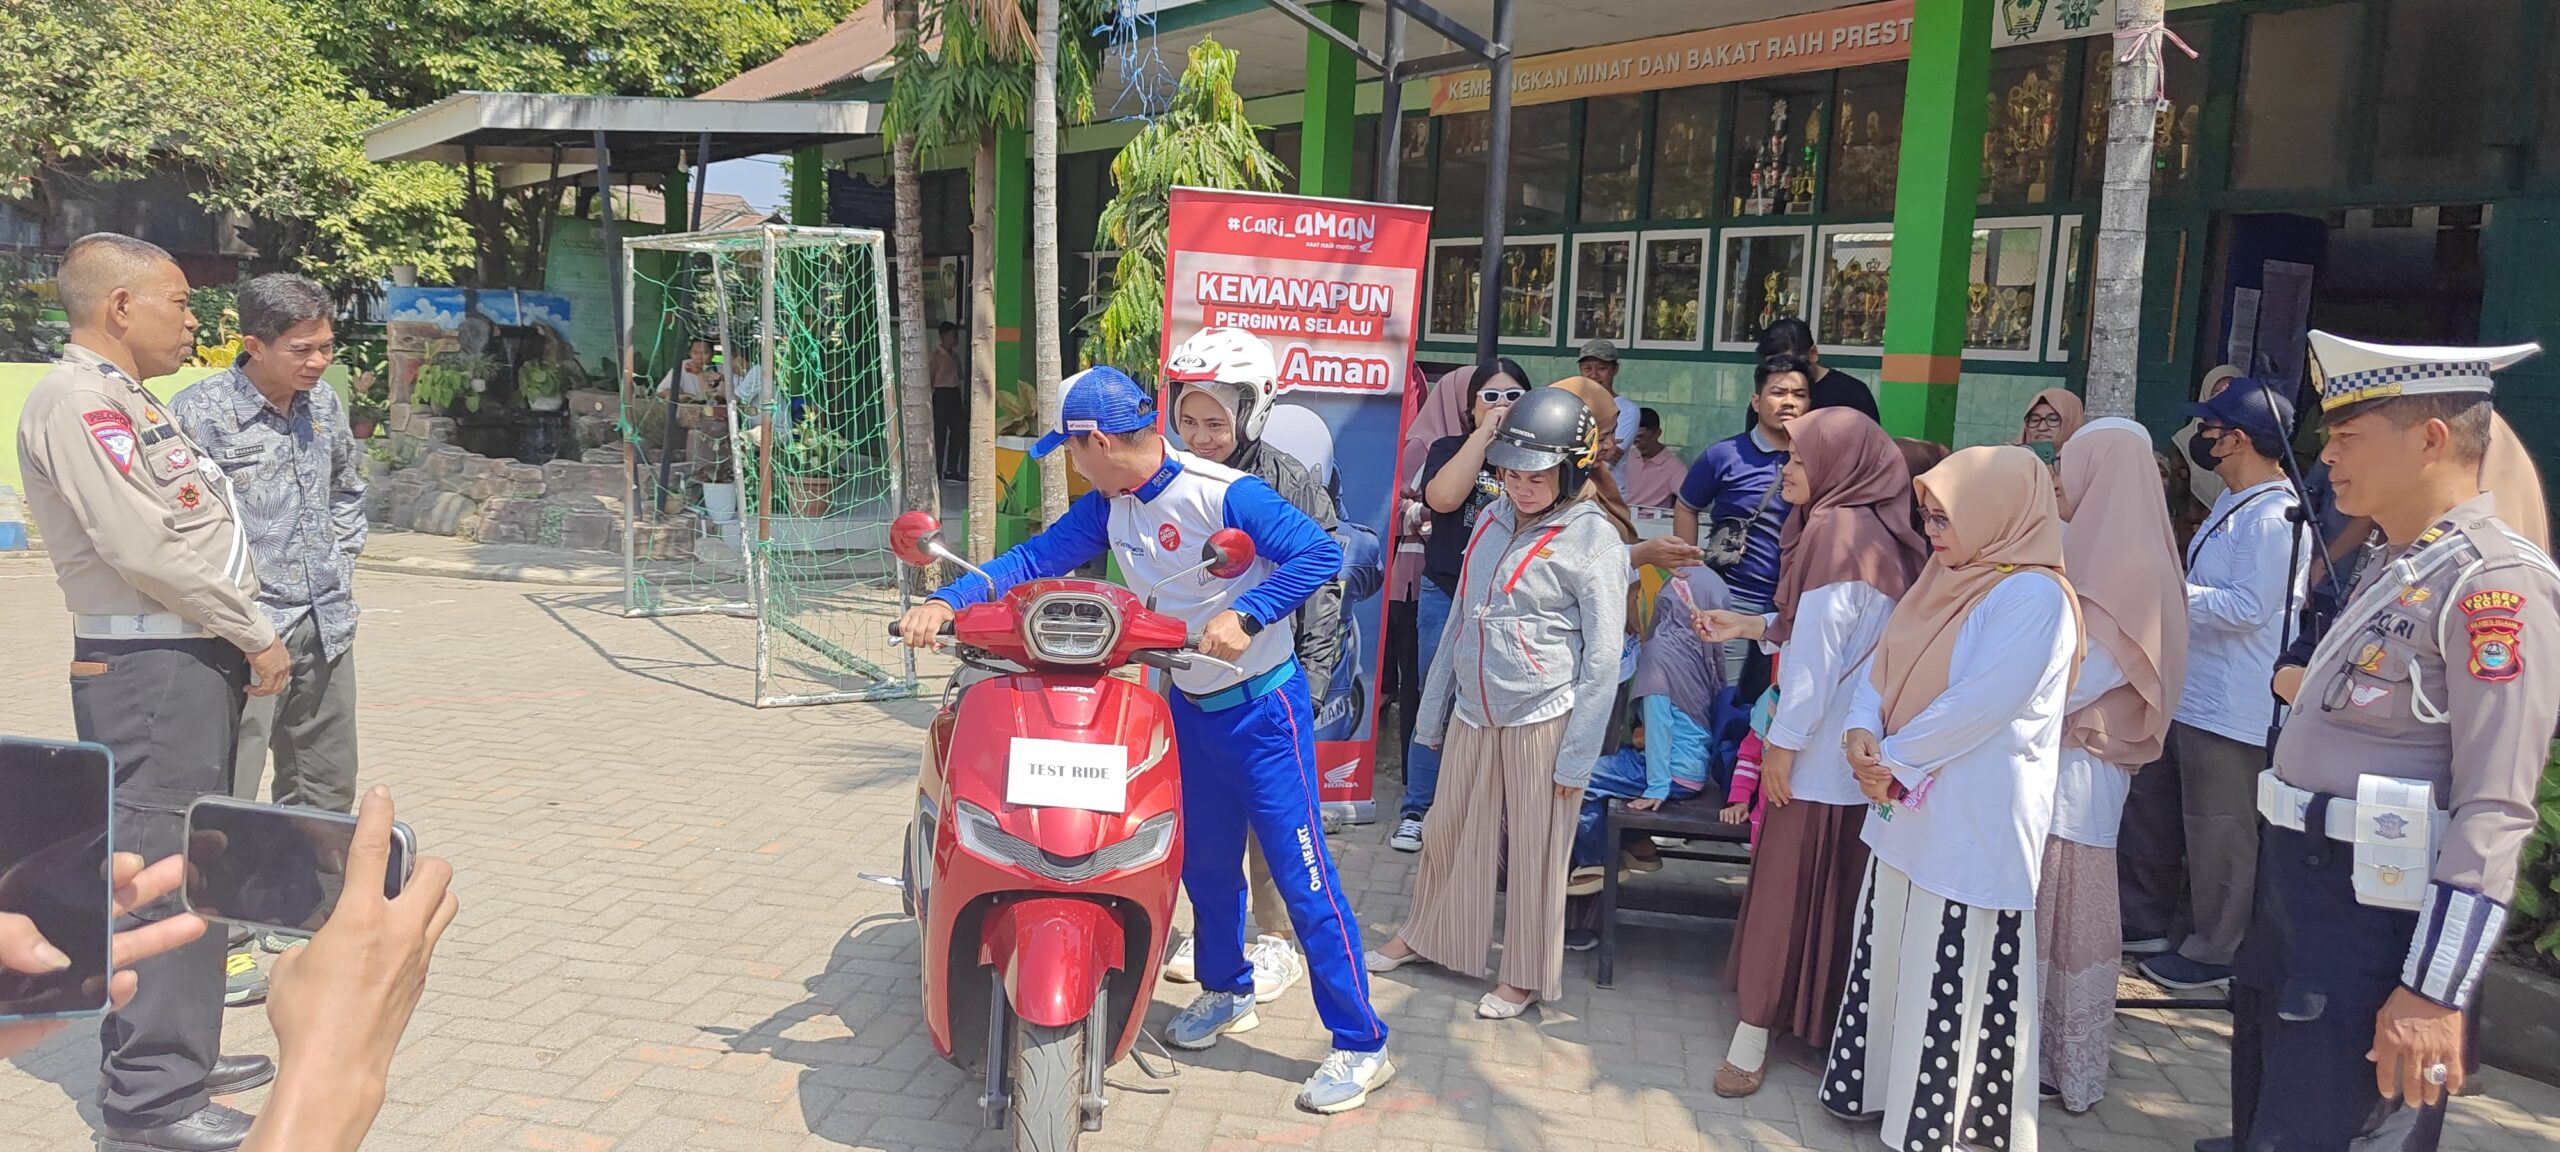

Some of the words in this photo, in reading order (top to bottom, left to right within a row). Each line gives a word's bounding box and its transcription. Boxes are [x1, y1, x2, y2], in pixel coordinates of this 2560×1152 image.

[1449, 69, 1569, 100] KEMBNGKAN
[1573, 58, 1634, 85] MINAT
[1638, 52, 1680, 77] DAN
[1687, 40, 1760, 70] BAKAT
[1766, 31, 1824, 60] RAIH
[1335, 243, 1356, 251] motor
[1197, 272, 1392, 315] KEMANAPUN
[1215, 311, 1300, 331] PERGINYA
[1304, 317, 1373, 336] SELALU
[1509, 427, 1536, 439] HONDA
[2465, 591, 2519, 609] POLRES
[1052, 685, 1096, 694] HONDA
[1028, 762, 1067, 777] TEST
[1071, 766, 1111, 780] RIDE
[1309, 866, 1321, 891] One
